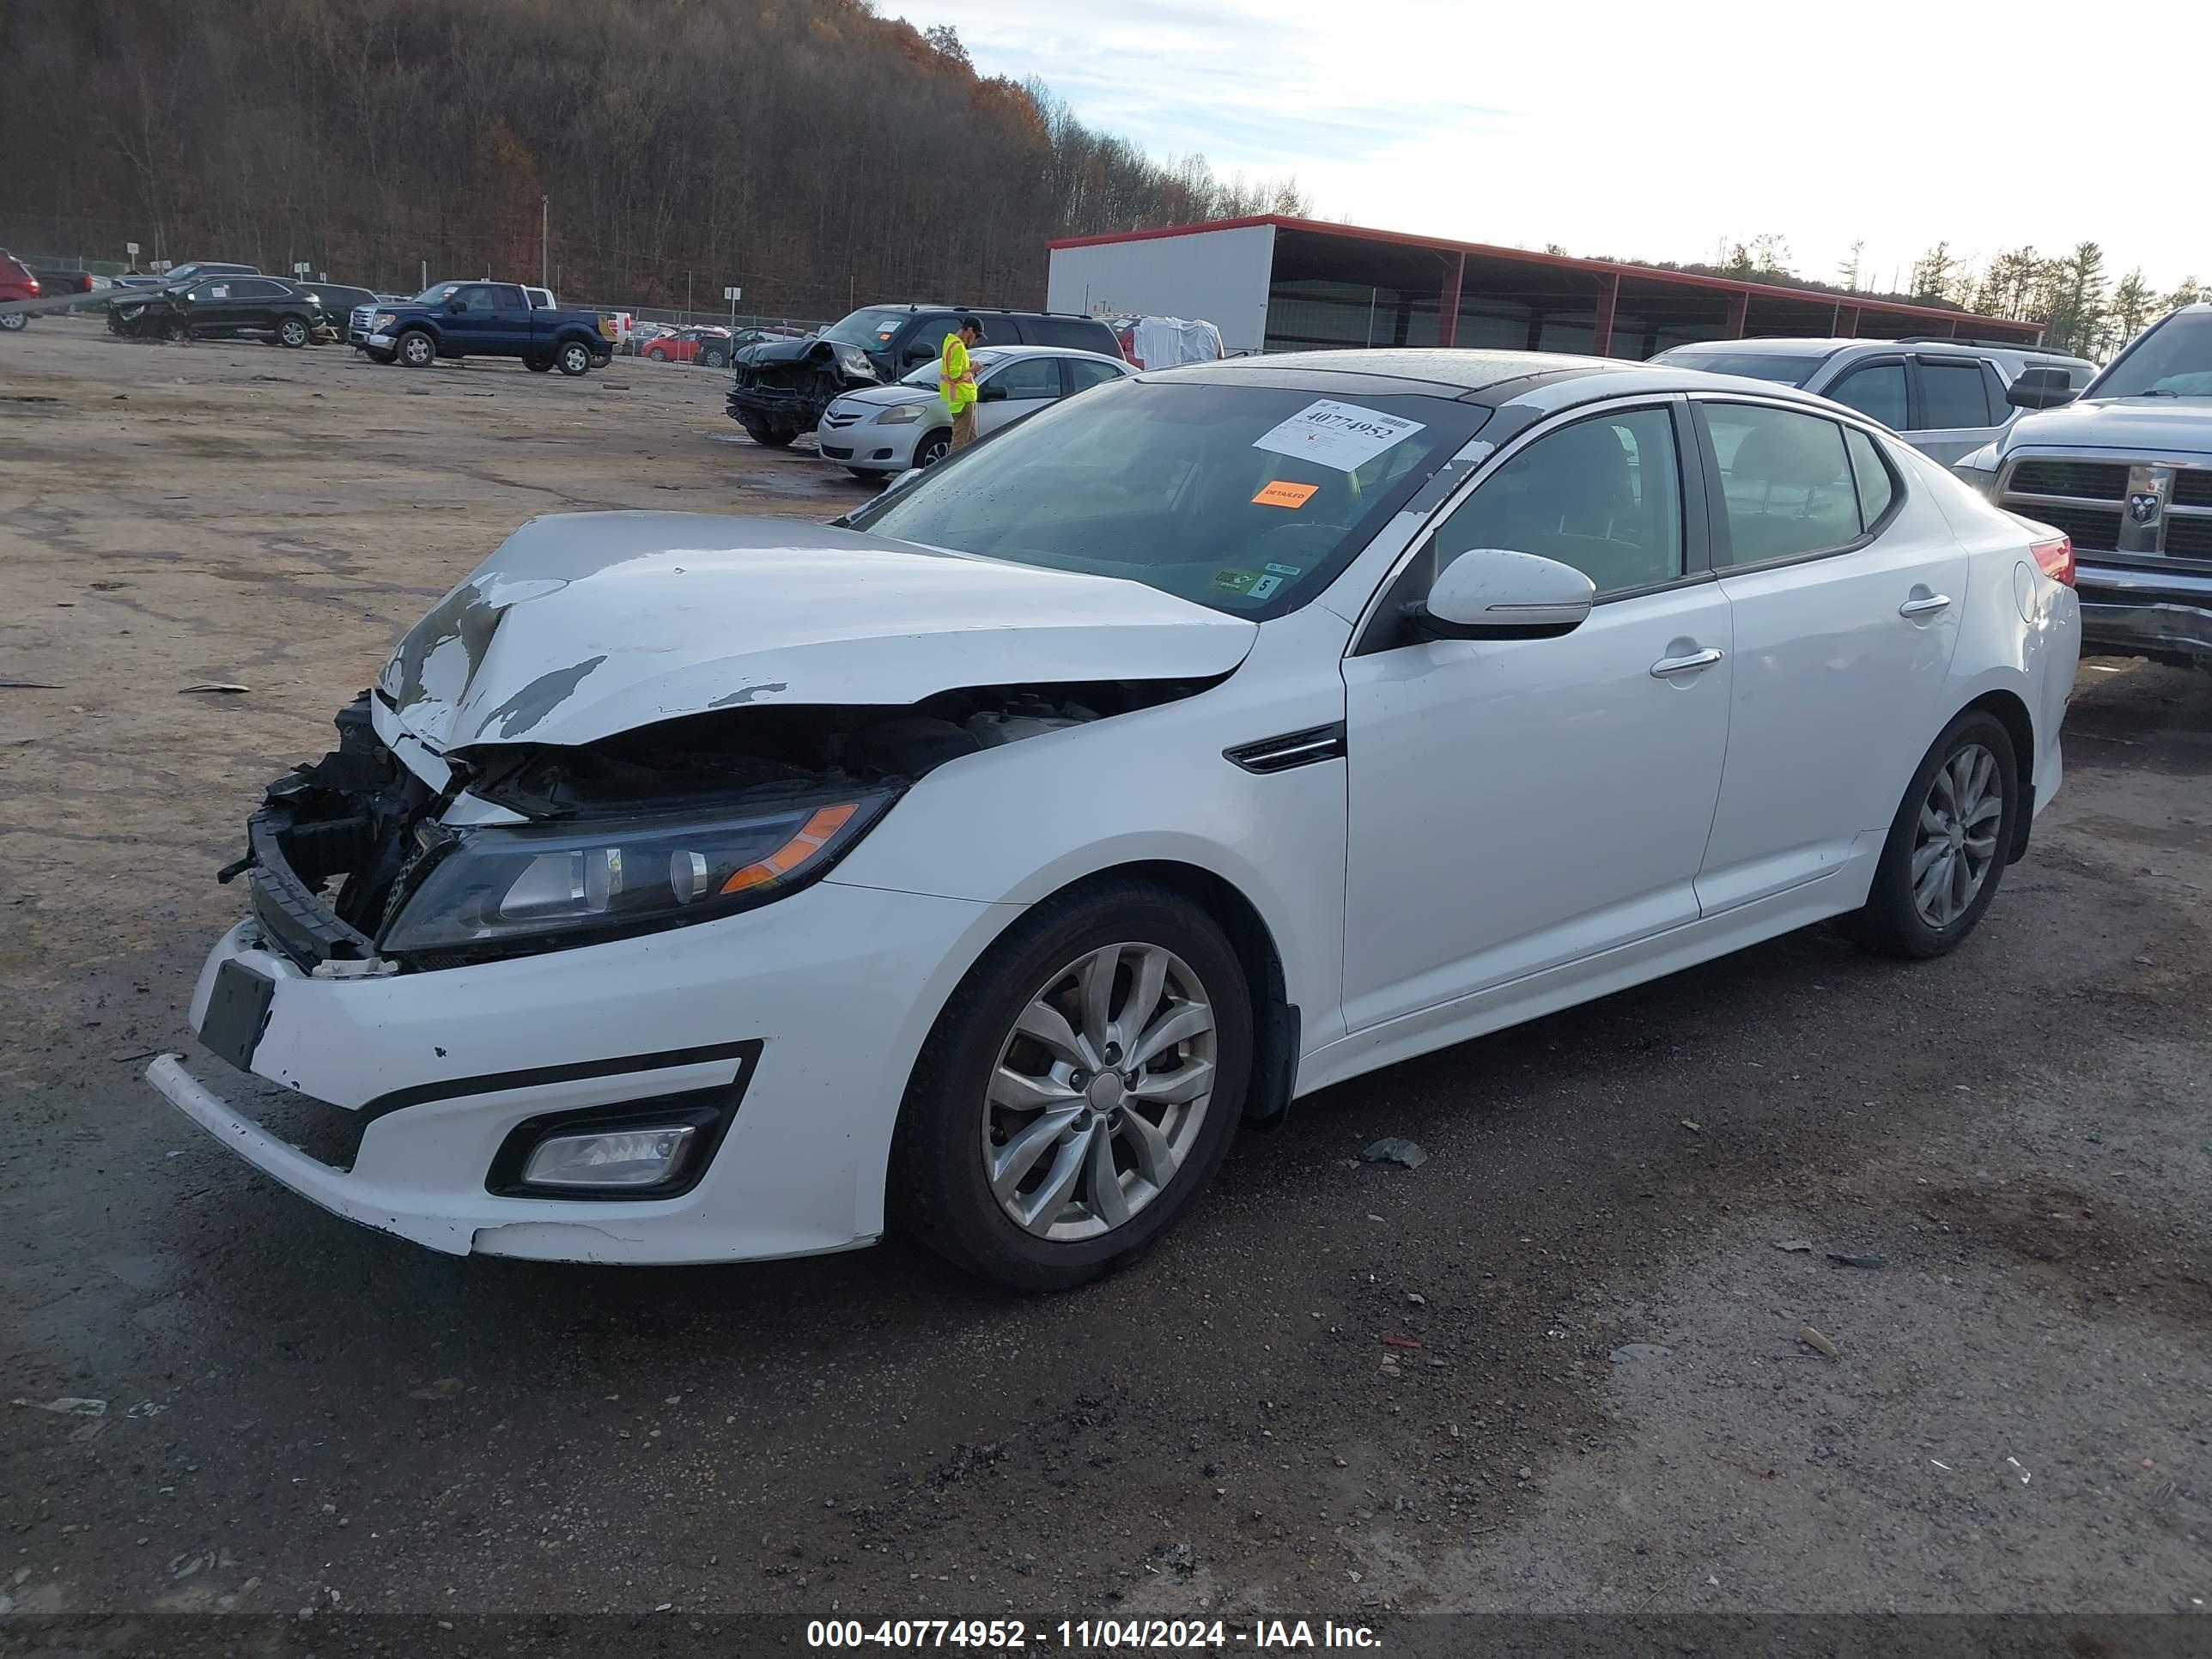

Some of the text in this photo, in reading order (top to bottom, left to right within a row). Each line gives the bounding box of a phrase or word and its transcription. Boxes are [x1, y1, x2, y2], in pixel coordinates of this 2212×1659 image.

[1306, 411, 1395, 439] 40774952
[1265, 489, 1304, 500] DETAILED
[1258, 580, 1271, 592] 5
